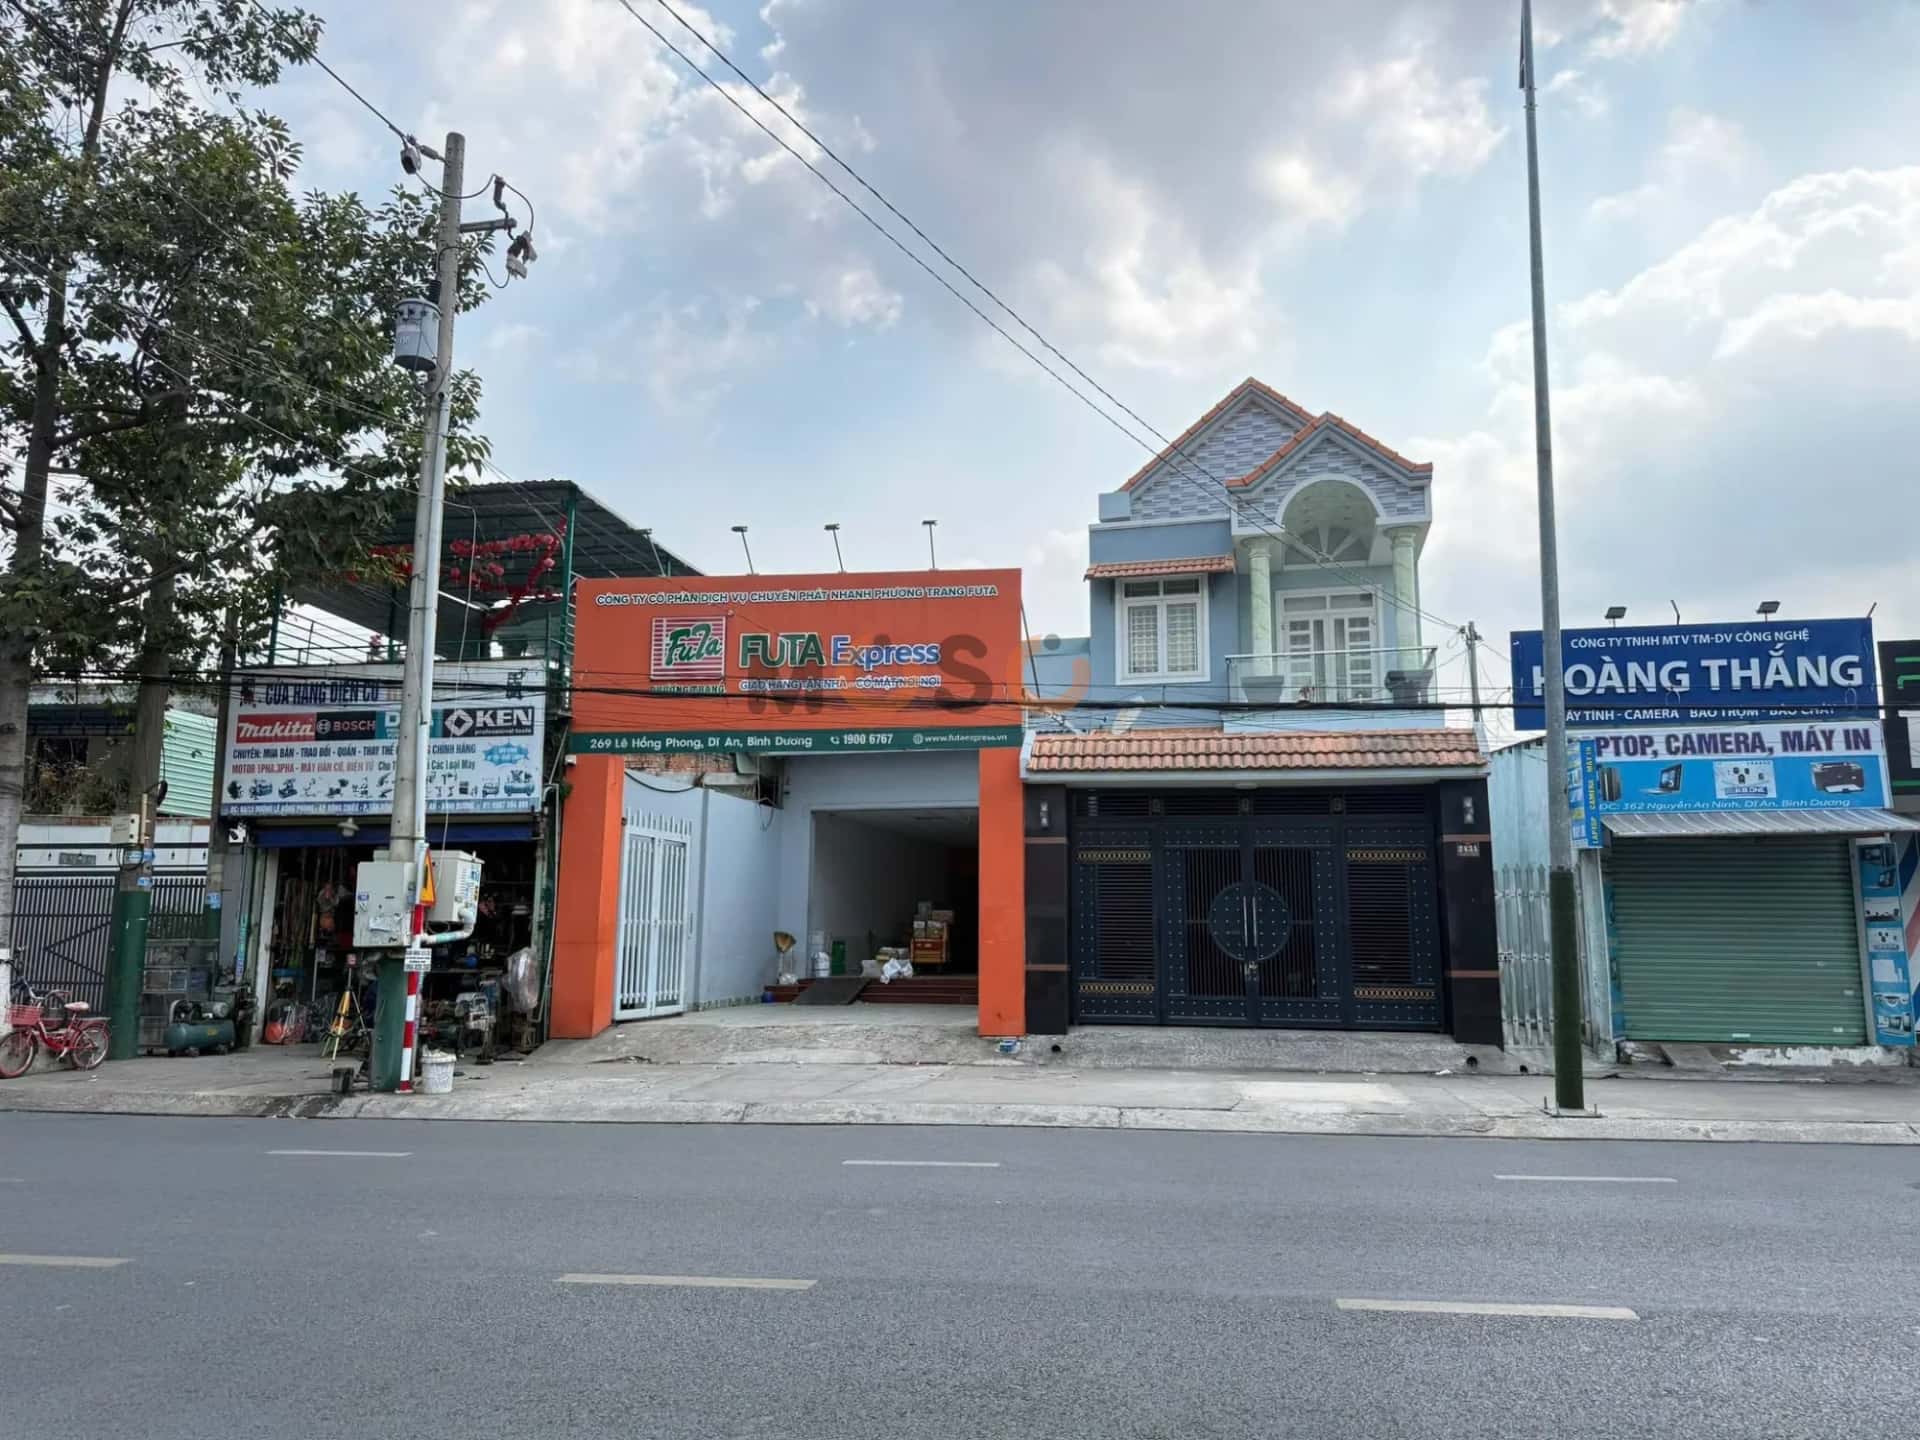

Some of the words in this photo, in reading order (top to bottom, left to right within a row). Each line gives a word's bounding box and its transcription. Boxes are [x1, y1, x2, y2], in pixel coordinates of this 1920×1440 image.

[596, 592, 630, 605] CÔNG
[631, 593, 649, 605] TY
[667, 589, 699, 604] PHẦN
[699, 592, 728, 605] DỊCH
[732, 592, 749, 605] VỤ
[750, 589, 798, 602] CHUYỂN
[798, 587, 829, 601] PHÁT
[830, 589, 873, 601] NHANH
[926, 586, 965, 598] TRANG
[967, 585, 998, 597] FUTA
[1570, 636, 1606, 648] CÔNG
[1608, 637, 1623, 647] TY
[1624, 636, 1660, 647] TNHH
[1662, 634, 1690, 646] MTV
[1735, 629, 1772, 643] CÔNG
[1774, 627, 1810, 643] NGHỆ
[739, 632, 827, 668] FUTA
[831, 634, 940, 671] Express
[1700, 643, 1863, 691] THẮNG
[739, 679, 768, 691] GIAO
[476, 708, 532, 727] KEN
[1624, 708, 1680, 720] CAMERA
[333, 719, 376, 732] BOSCH
[590, 738, 612, 750] 269
[614, 737, 628, 750] Lê
[631, 736, 662, 751] Hồng
[665, 736, 704, 750] Phong,
[724, 736, 743, 749] An,
[747, 735, 771, 747] Bình
[775, 735, 813, 748] Dương
[843, 733, 866, 745] 1900
[869, 733, 893, 745] 6767
[1596, 735, 1659, 758] PTOP,
[1665, 731, 1774, 756] CAMERA,
[1780, 725, 1836, 753] MÁY
[1843, 728, 1873, 751] IN
